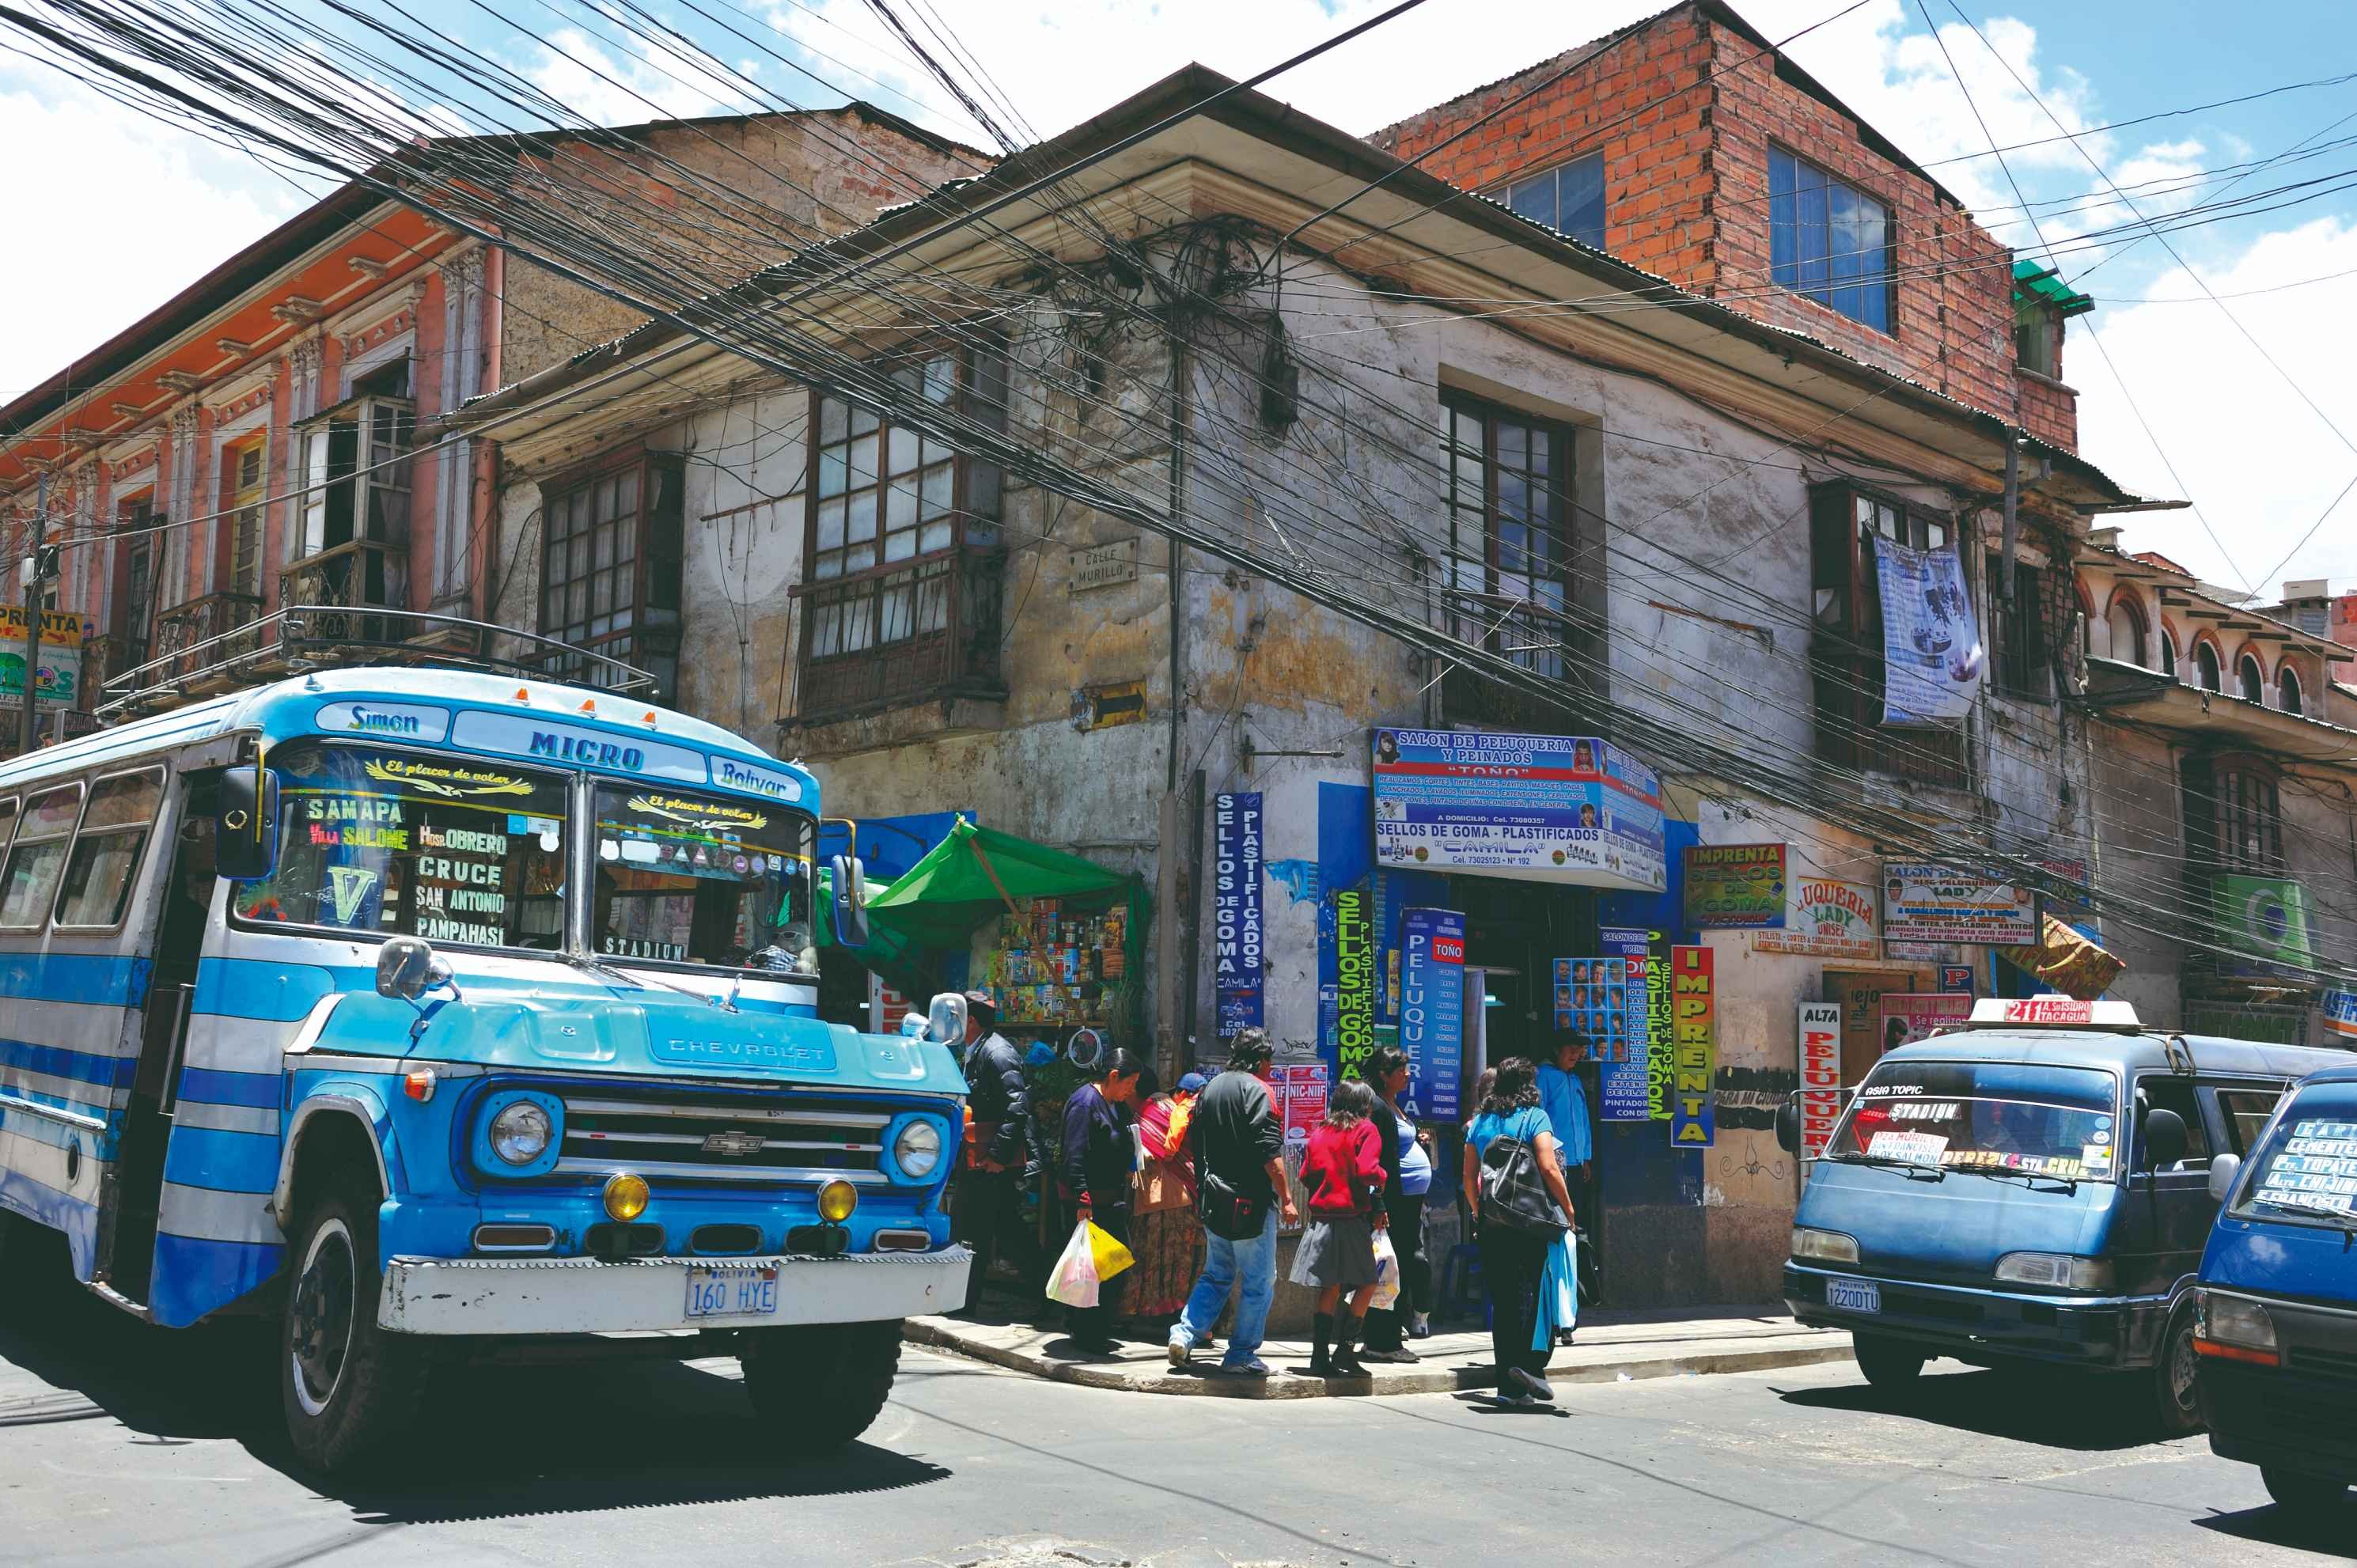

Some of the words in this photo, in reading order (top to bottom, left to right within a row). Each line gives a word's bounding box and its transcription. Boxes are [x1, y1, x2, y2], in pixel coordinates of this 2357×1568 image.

[1086, 549, 1117, 565] CALLE
[1079, 564, 1123, 582] MURILLO
[529, 731, 644, 772] MICRO
[1399, 731, 1449, 747] SALON
[1453, 735, 1476, 748] DE
[1480, 736, 1573, 752] PELUQUERIA
[1442, 749, 1455, 762] Y
[1458, 750, 1533, 765] PEINADOS
[385, 759, 404, 772] El
[405, 764, 449, 778] placer
[453, 768, 470, 779] de
[472, 772, 510, 785] volar
[721, 763, 787, 797] Bolivar
[309, 799, 402, 824] SAMAPA
[648, 794, 664, 806] El
[665, 797, 703, 813] placer
[707, 803, 720, 814] de
[721, 806, 753, 820] volar
[343, 826, 409, 850] SALOME
[445, 829, 507, 855] OBRERO
[1217, 794, 1235, 891] SELLOS
[1377, 823, 1427, 836] SELLOS
[1431, 825, 1448, 837] DE
[1453, 825, 1491, 838] GOMA
[1502, 828, 1599, 842] PLASTIFICADOS
[1434, 840, 1545, 854] "CAMILA"
[1693, 846, 1779, 864] IMPRENTA
[1453, 855, 1466, 864] Cel.
[1468, 855, 1501, 865] 73025123
[1518, 857, 1531, 865] 192
[419, 856, 502, 885] CRUCE
[1690, 865, 1782, 881] SELLOS
[1885, 867, 1934, 878] SALON
[328, 865, 377, 924] V
[1242, 811, 1260, 968] PLASTIFICADOS
[1724, 882, 1748, 894] DE
[1934, 886, 1981, 897] LADY
[416, 885, 443, 907] SAN
[449, 890, 505, 914] ANTONIO
[1215, 896, 1239, 907] DE
[1703, 896, 1775, 911] GOMA
[1813, 906, 1855, 928] LADY
[416, 917, 504, 946] PAMPAHASI
[1602, 932, 1628, 942] SALON
[1817, 922, 1845, 937] UNISEX
[606, 936, 684, 962] STADIUM
[1216, 909, 1236, 972] GOMA
[1338, 892, 1360, 989] SELLOS
[1436, 943, 1462, 957] TOÑO
[1627, 959, 1646, 974] OÑ
[1339, 993, 1362, 1010] DE
[1661, 963, 1672, 1024] SELLOS
[1805, 1009, 1839, 1023] ALTA
[1916, 1015, 1927, 1025] Se
[1931, 1016, 1962, 1025] realiza
[2010, 1001, 2041, 1021] 211
[2041, 1012, 2086, 1022] TACAGUA
[1404, 935, 1425, 1116] PELUQUERIA
[1661, 1028, 1673, 1039] DE
[669, 1039, 825, 1059] CHEVROLET
[1339, 1013, 1362, 1080] GOMA
[1676, 950, 1710, 1142] IMPRENTA
[1663, 1043, 1674, 1085] GOMA
[1290, 1085, 1326, 1098] NIC-NIIF
[1715, 1092, 1739, 1105] PARA
[1741, 1092, 1754, 1105] MI
[1804, 1032, 1840, 1157] PELUQUER
[1866, 1086, 1889, 1096] ASIA
[1892, 1085, 1924, 1095] TOPIC
[1891, 1103, 1958, 1120] STADIUM
[1942, 1151, 2000, 1165] PEREZ
[2048, 1157, 2090, 1176] CRUZ
[711, 1270, 756, 1279] BOLIVIA
[693, 1282, 726, 1310] 160
[738, 1282, 774, 1309] HYE
[1829, 1288, 1878, 1309] 1220DTU
